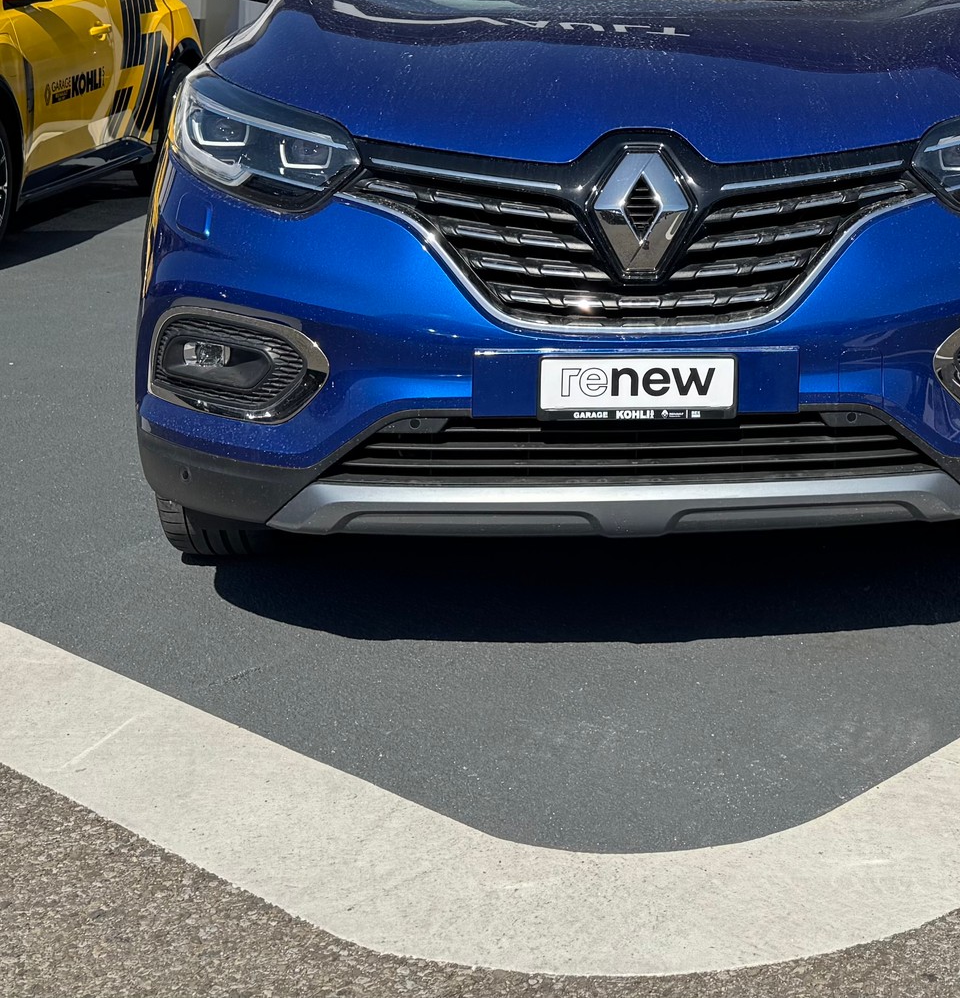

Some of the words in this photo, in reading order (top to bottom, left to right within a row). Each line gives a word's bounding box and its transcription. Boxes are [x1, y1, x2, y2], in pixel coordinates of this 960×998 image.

[51, 76, 72, 93] GARAGE
[72, 67, 102, 98] KOHLI
[560, 367, 716, 398] renew
[573, 411, 609, 419] GARAGE
[615, 410, 650, 419] KOHLI
